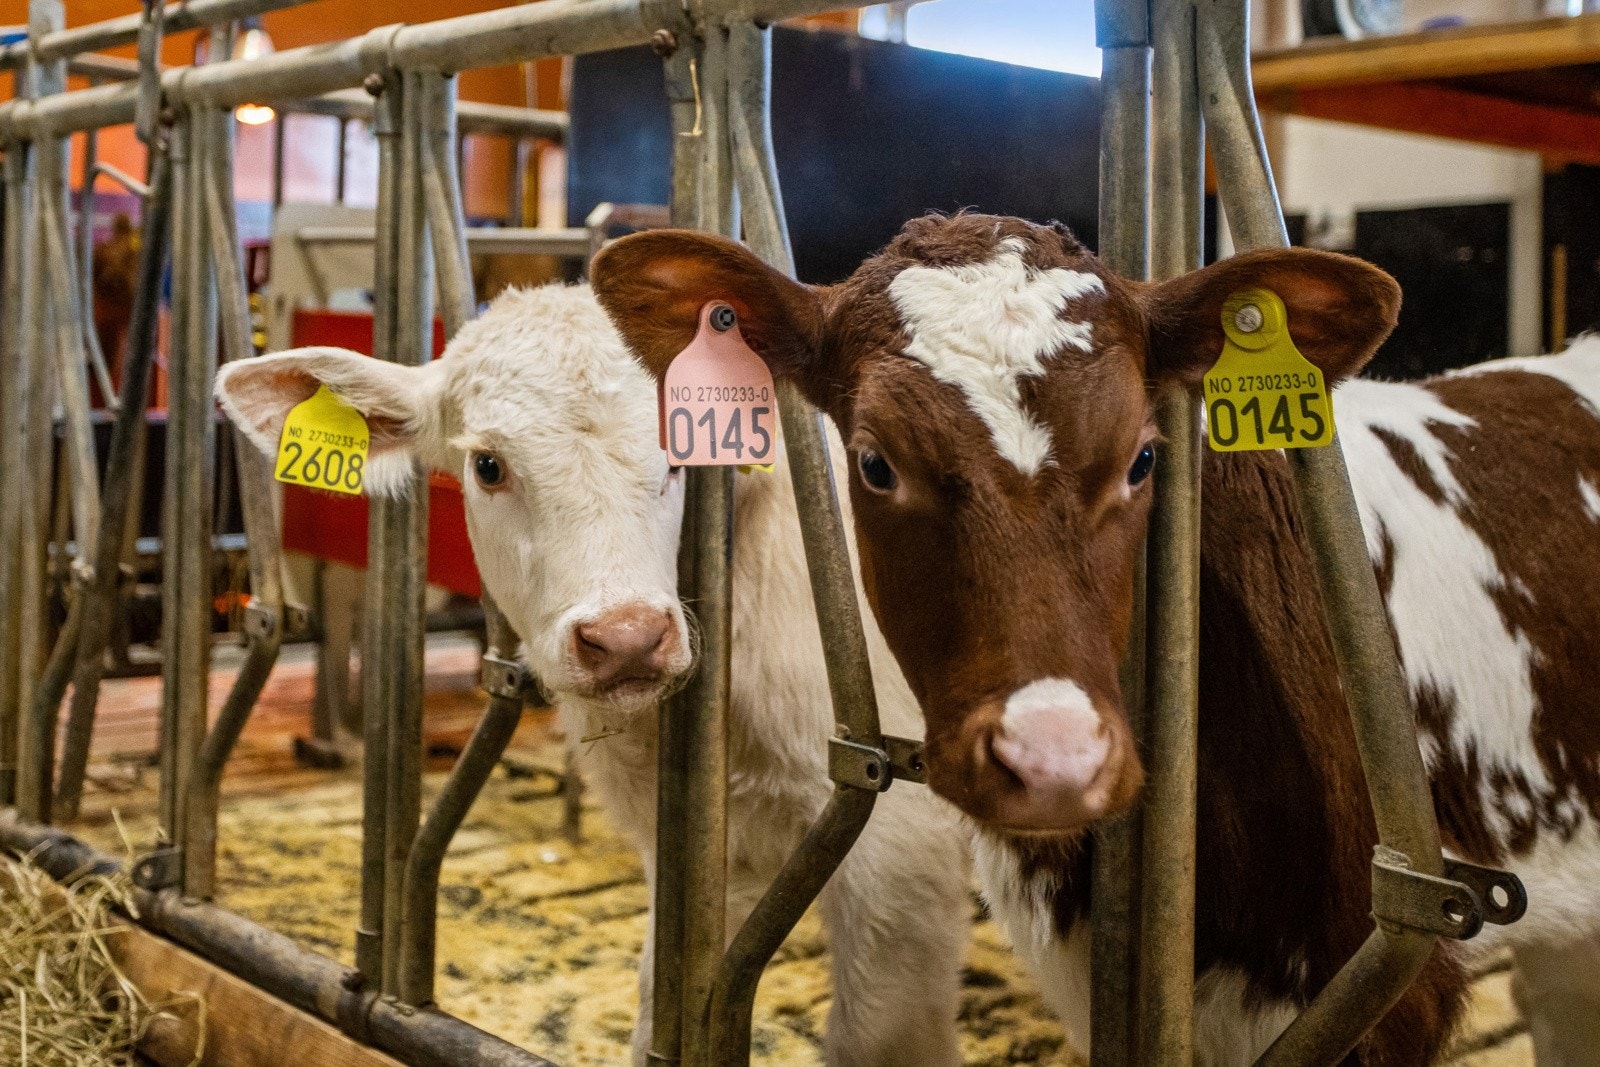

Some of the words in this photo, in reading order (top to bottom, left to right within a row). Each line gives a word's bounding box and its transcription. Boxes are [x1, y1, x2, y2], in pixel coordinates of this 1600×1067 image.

[670, 386, 691, 402] NO
[697, 386, 769, 402] 2730233-0
[1209, 377, 1232, 393] NO
[1238, 372, 1317, 392] 2730233-0
[288, 425, 302, 438] NO
[669, 407, 771, 460] 0145
[1210, 392, 1325, 447] 0145
[279, 441, 364, 490] 2608
